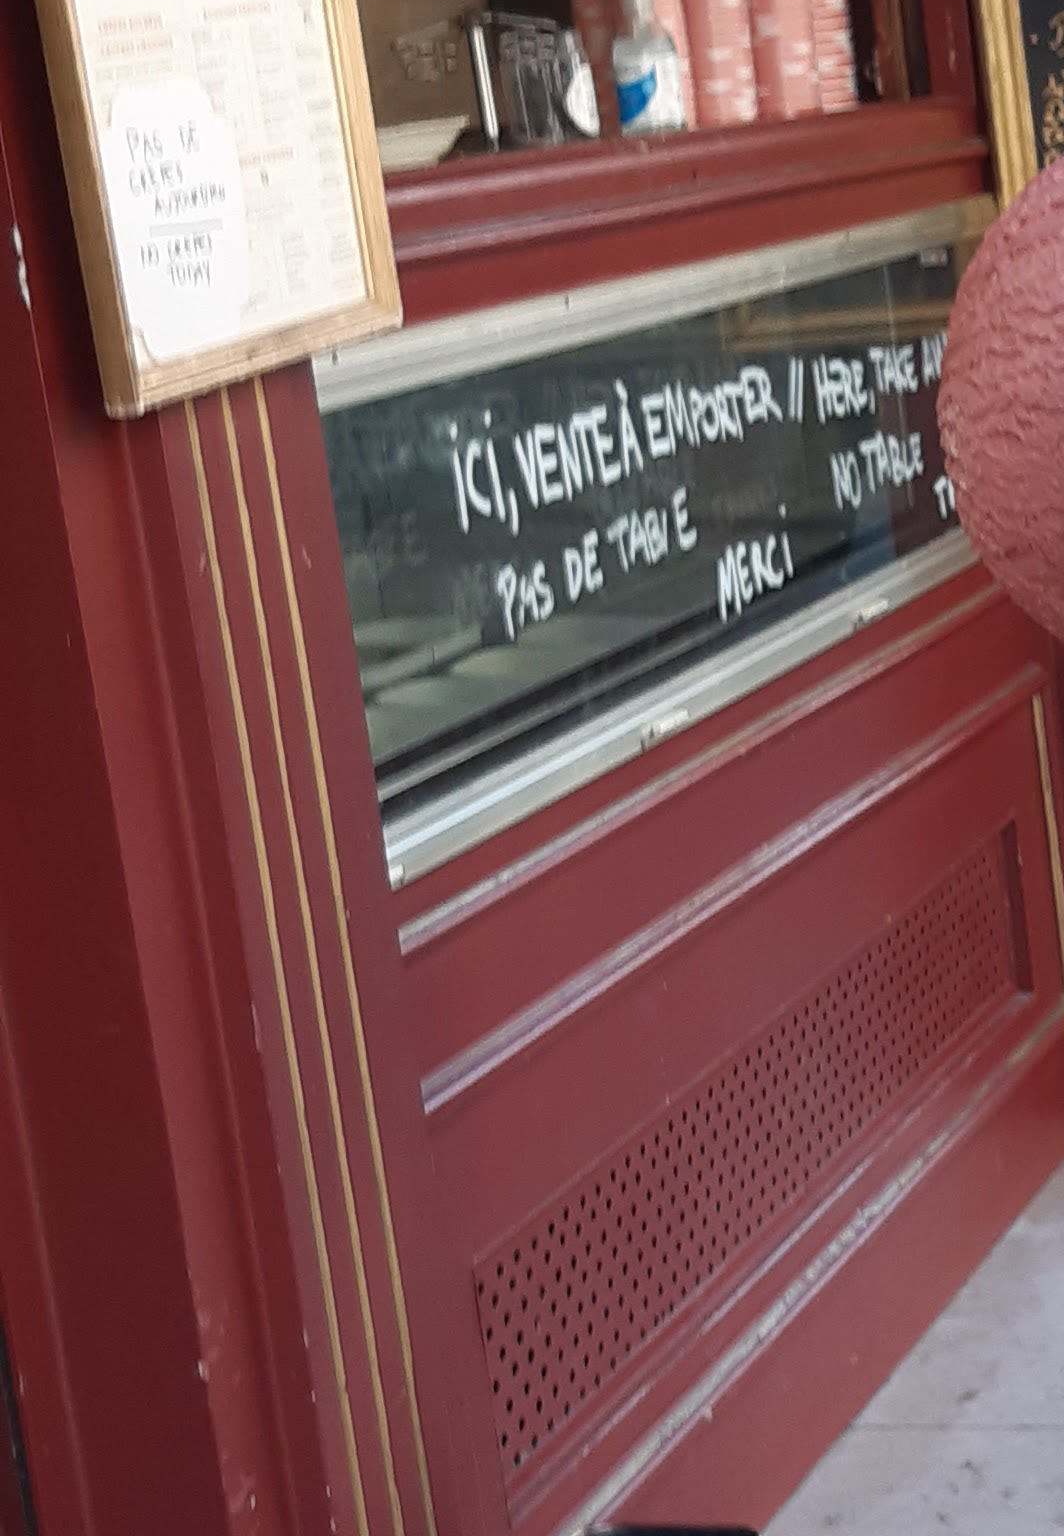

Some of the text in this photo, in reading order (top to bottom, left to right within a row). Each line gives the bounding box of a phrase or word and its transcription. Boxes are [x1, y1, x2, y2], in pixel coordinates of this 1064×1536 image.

[512, 404, 622, 511] VENTE
[613, 376, 645, 478] À
[640, 363, 784, 461] EMPORTER
[867, 342, 919, 395] TAKE
[828, 449, 863, 511] NO
[857, 429, 925, 494] TABLE
[495, 558, 555, 642] PAS
[562, 527, 605, 604] DE
